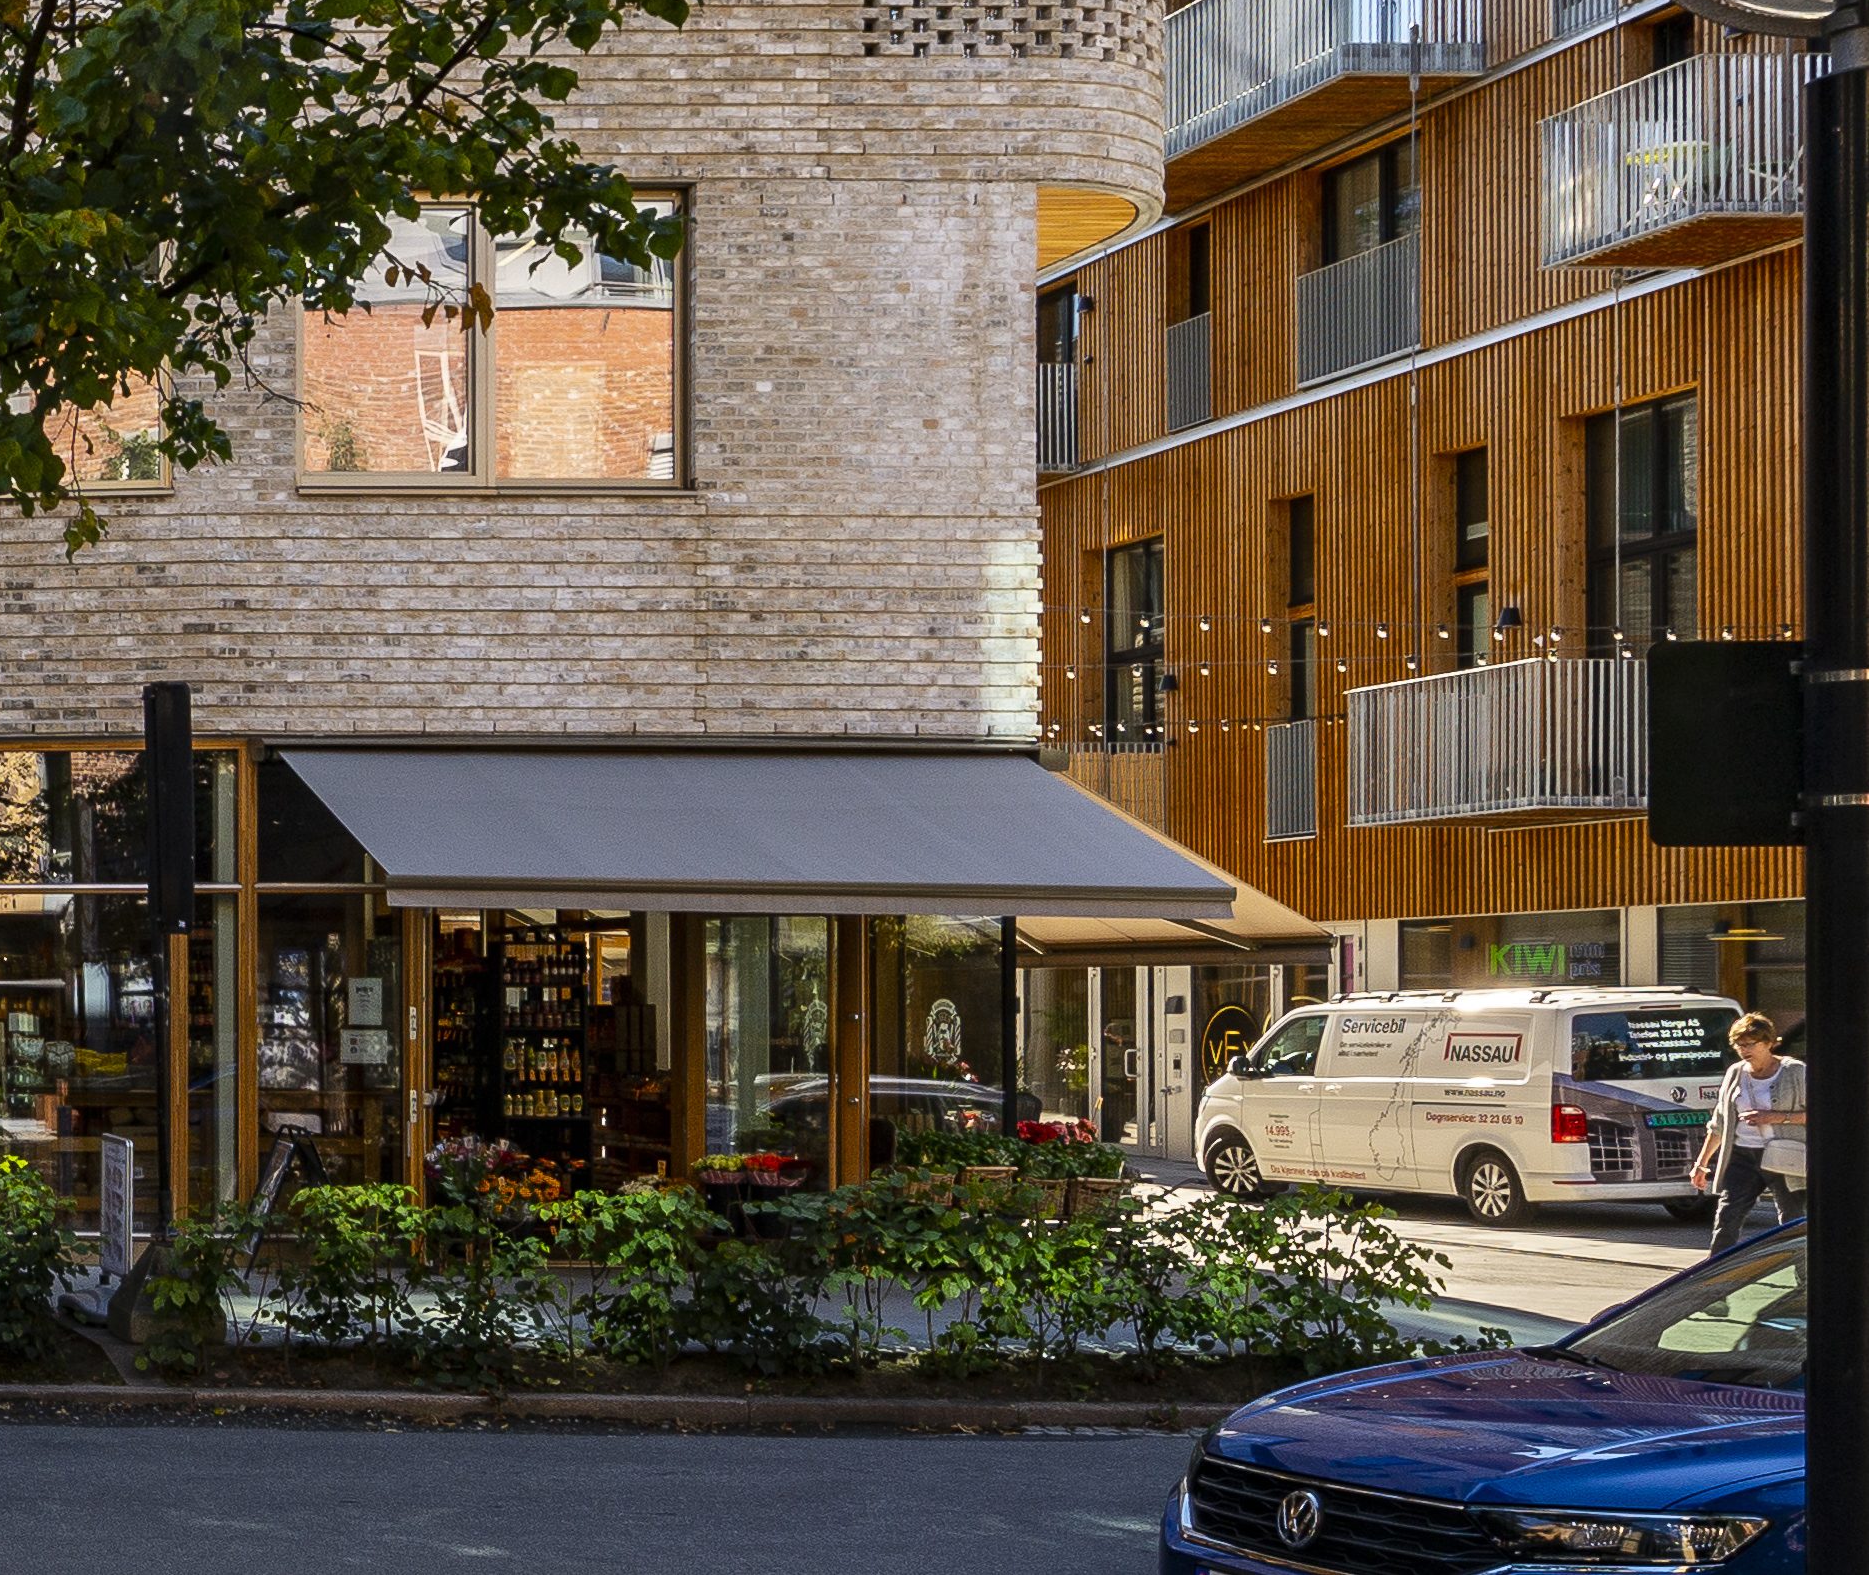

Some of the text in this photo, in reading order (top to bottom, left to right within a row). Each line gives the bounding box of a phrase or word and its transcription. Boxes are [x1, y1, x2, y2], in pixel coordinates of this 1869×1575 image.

[1490, 943, 1565, 975] KIWI
[1341, 1018, 1407, 1034] Servicebil
[1450, 1044, 1514, 1063] NASSAU
[1478, 1114, 1488, 1123] 32
[1490, 1114, 1500, 1123] 23
